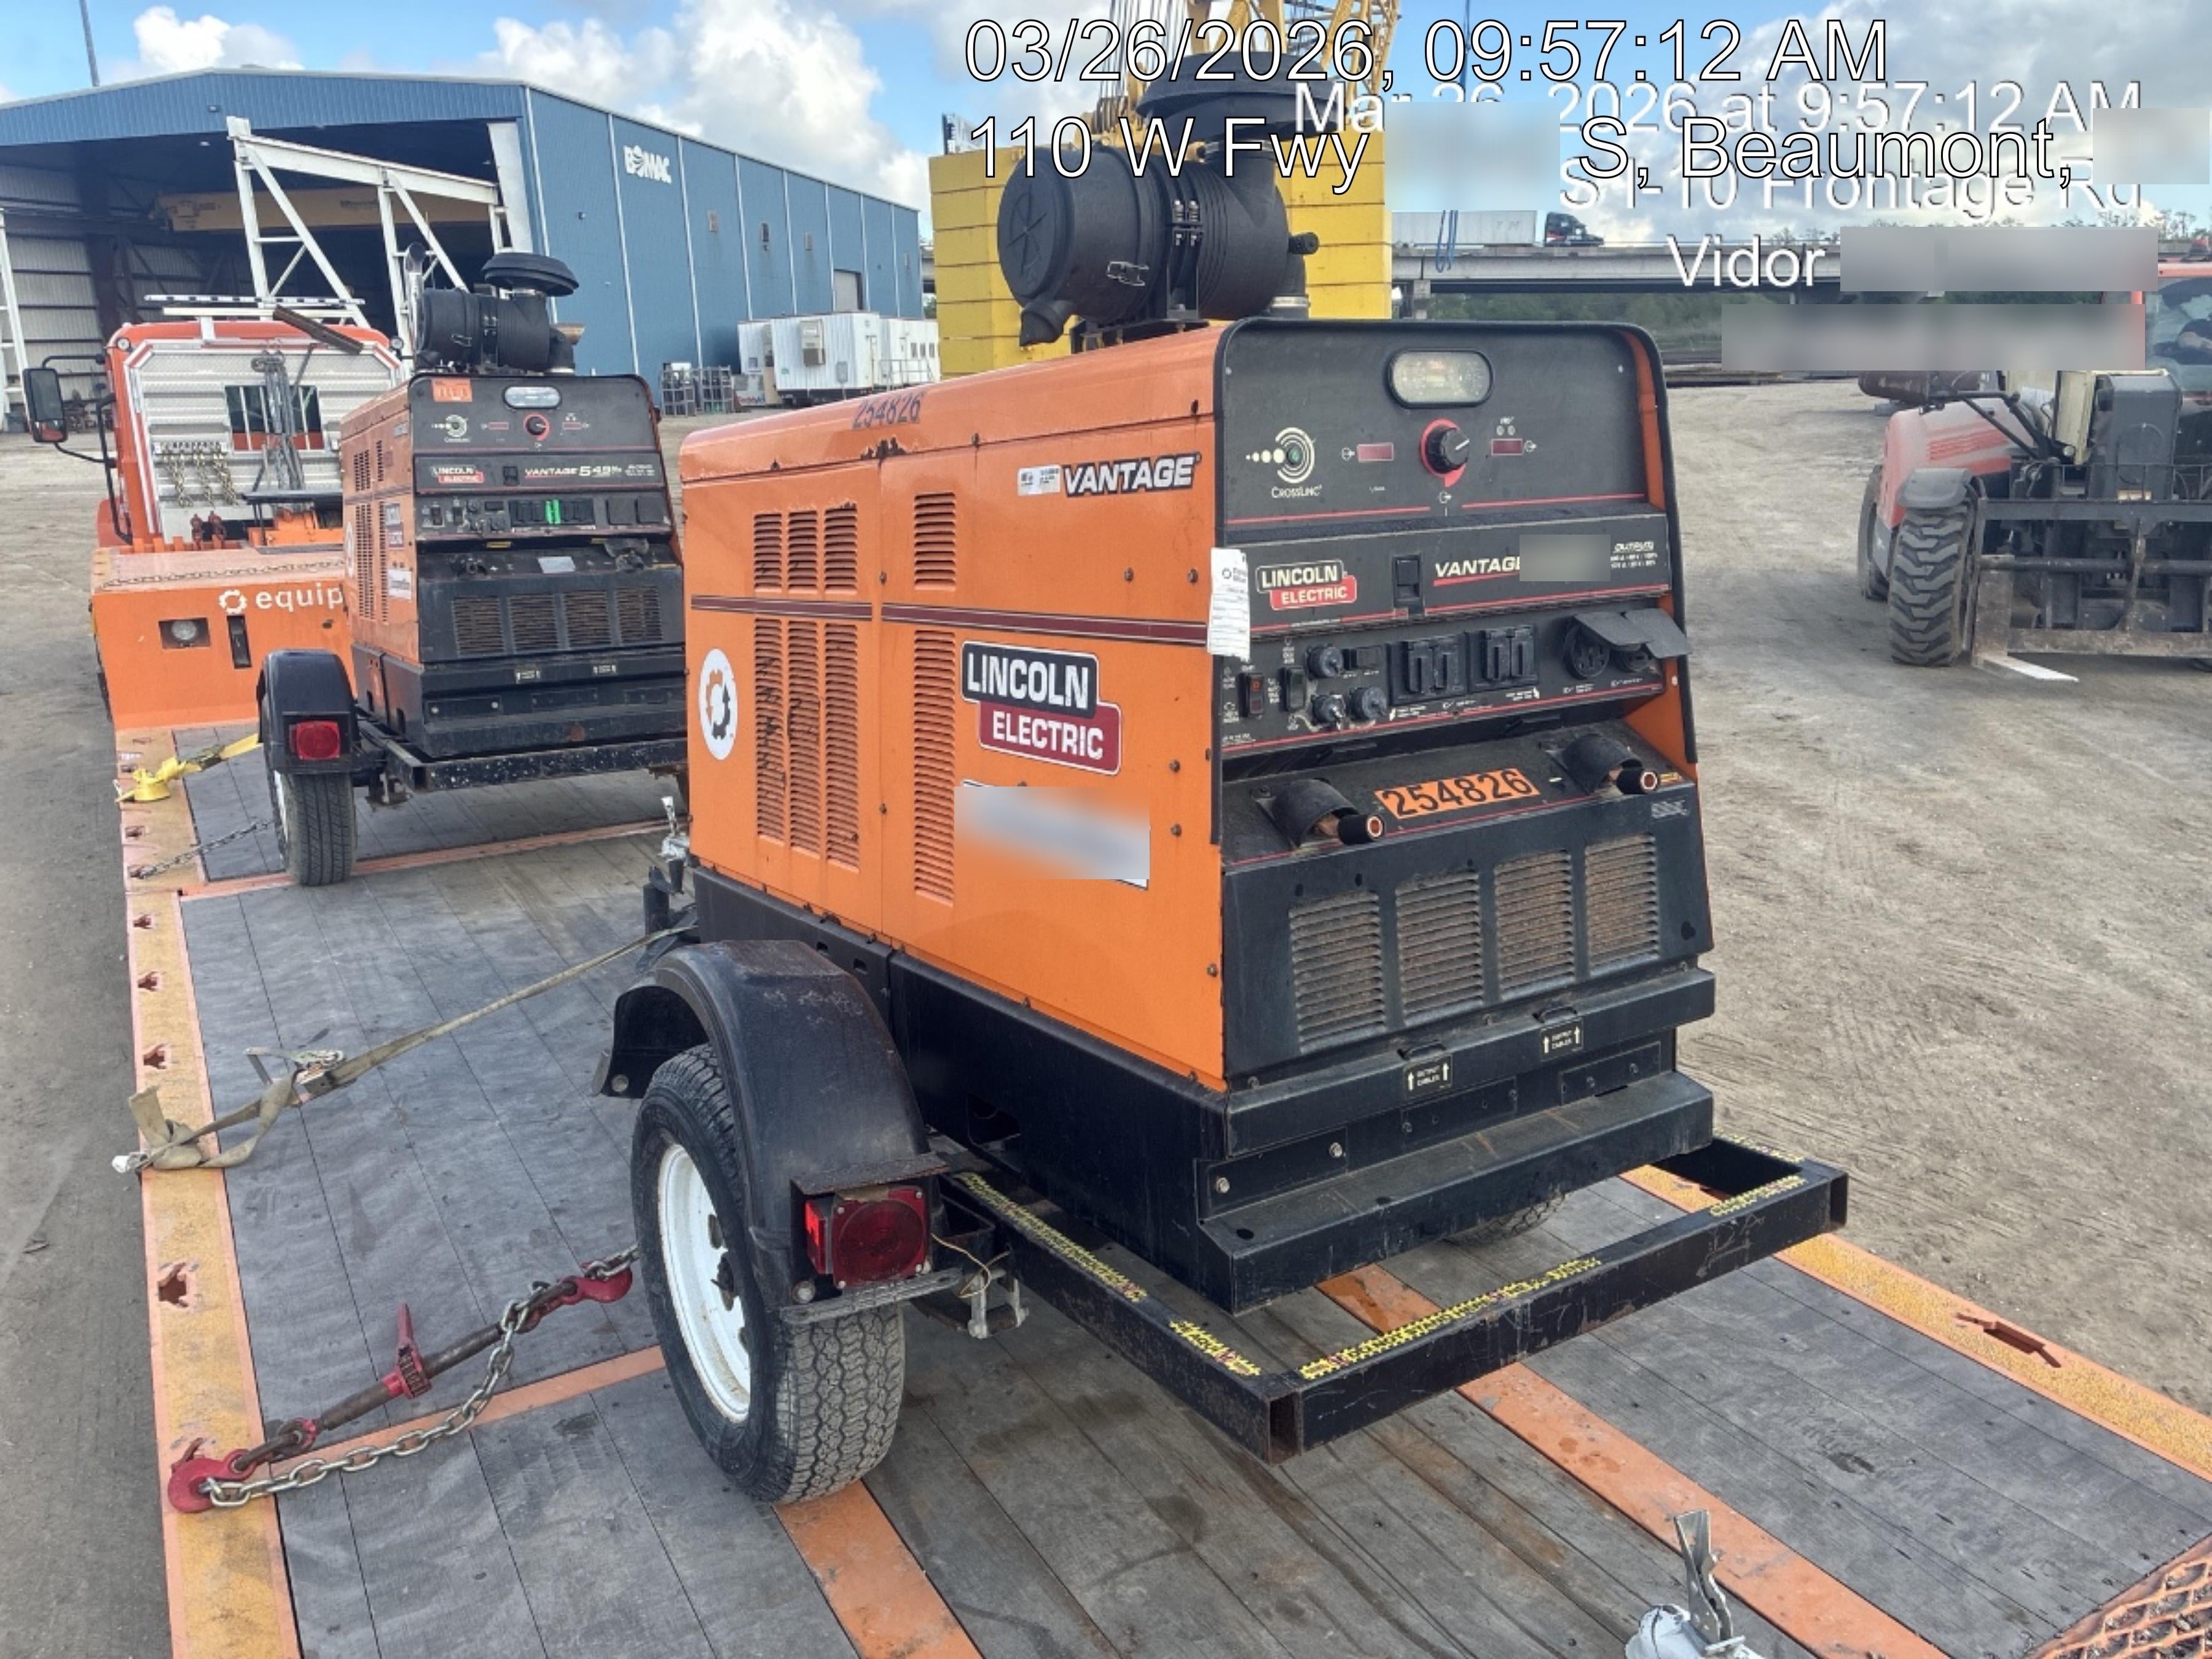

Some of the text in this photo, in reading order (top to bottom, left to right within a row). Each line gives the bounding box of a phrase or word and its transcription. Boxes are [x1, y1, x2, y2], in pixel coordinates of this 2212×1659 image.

[1062, 455, 1195, 495] VANTAGE
[1261, 565, 1338, 589] LINCOLN
[1281, 586, 1347, 605] ELECTRIC
[967, 653, 1089, 709] LINCOLN
[992, 710, 1104, 760] ELECTRIC
[1382, 770, 1532, 817] 254826
